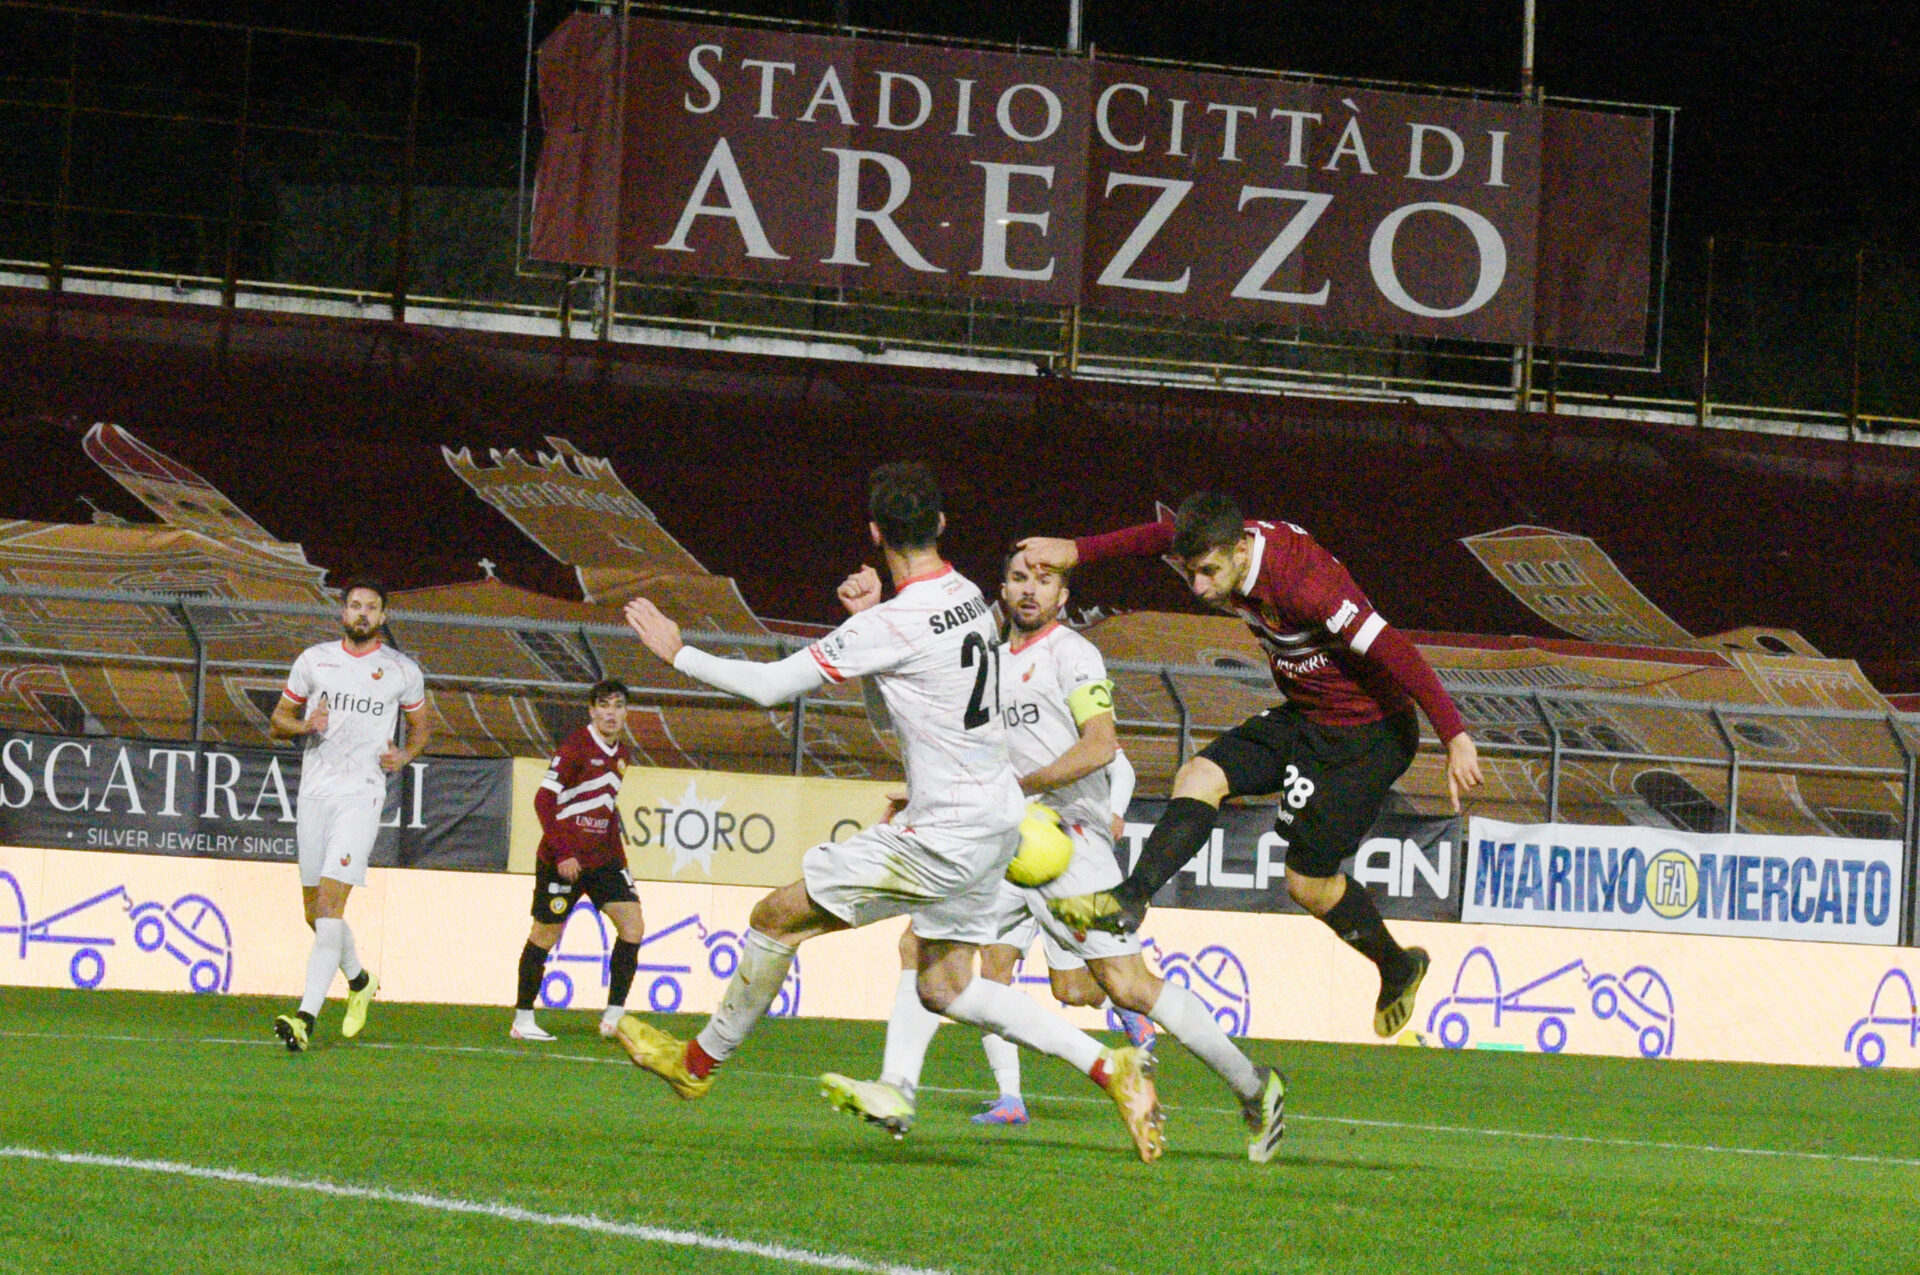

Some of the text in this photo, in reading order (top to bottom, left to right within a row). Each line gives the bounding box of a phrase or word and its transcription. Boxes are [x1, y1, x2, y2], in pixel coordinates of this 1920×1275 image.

[684, 43, 1511, 187] STADIO CITTÀ DI
[654, 137, 1508, 319] AREZZO
[320, 690, 385, 716] Affida
[960, 630, 1000, 731] 21
[86, 827, 296, 856] SILVER JEWELRY SINCE
[1473, 839, 1892, 927] MARINO FA MERCATO
